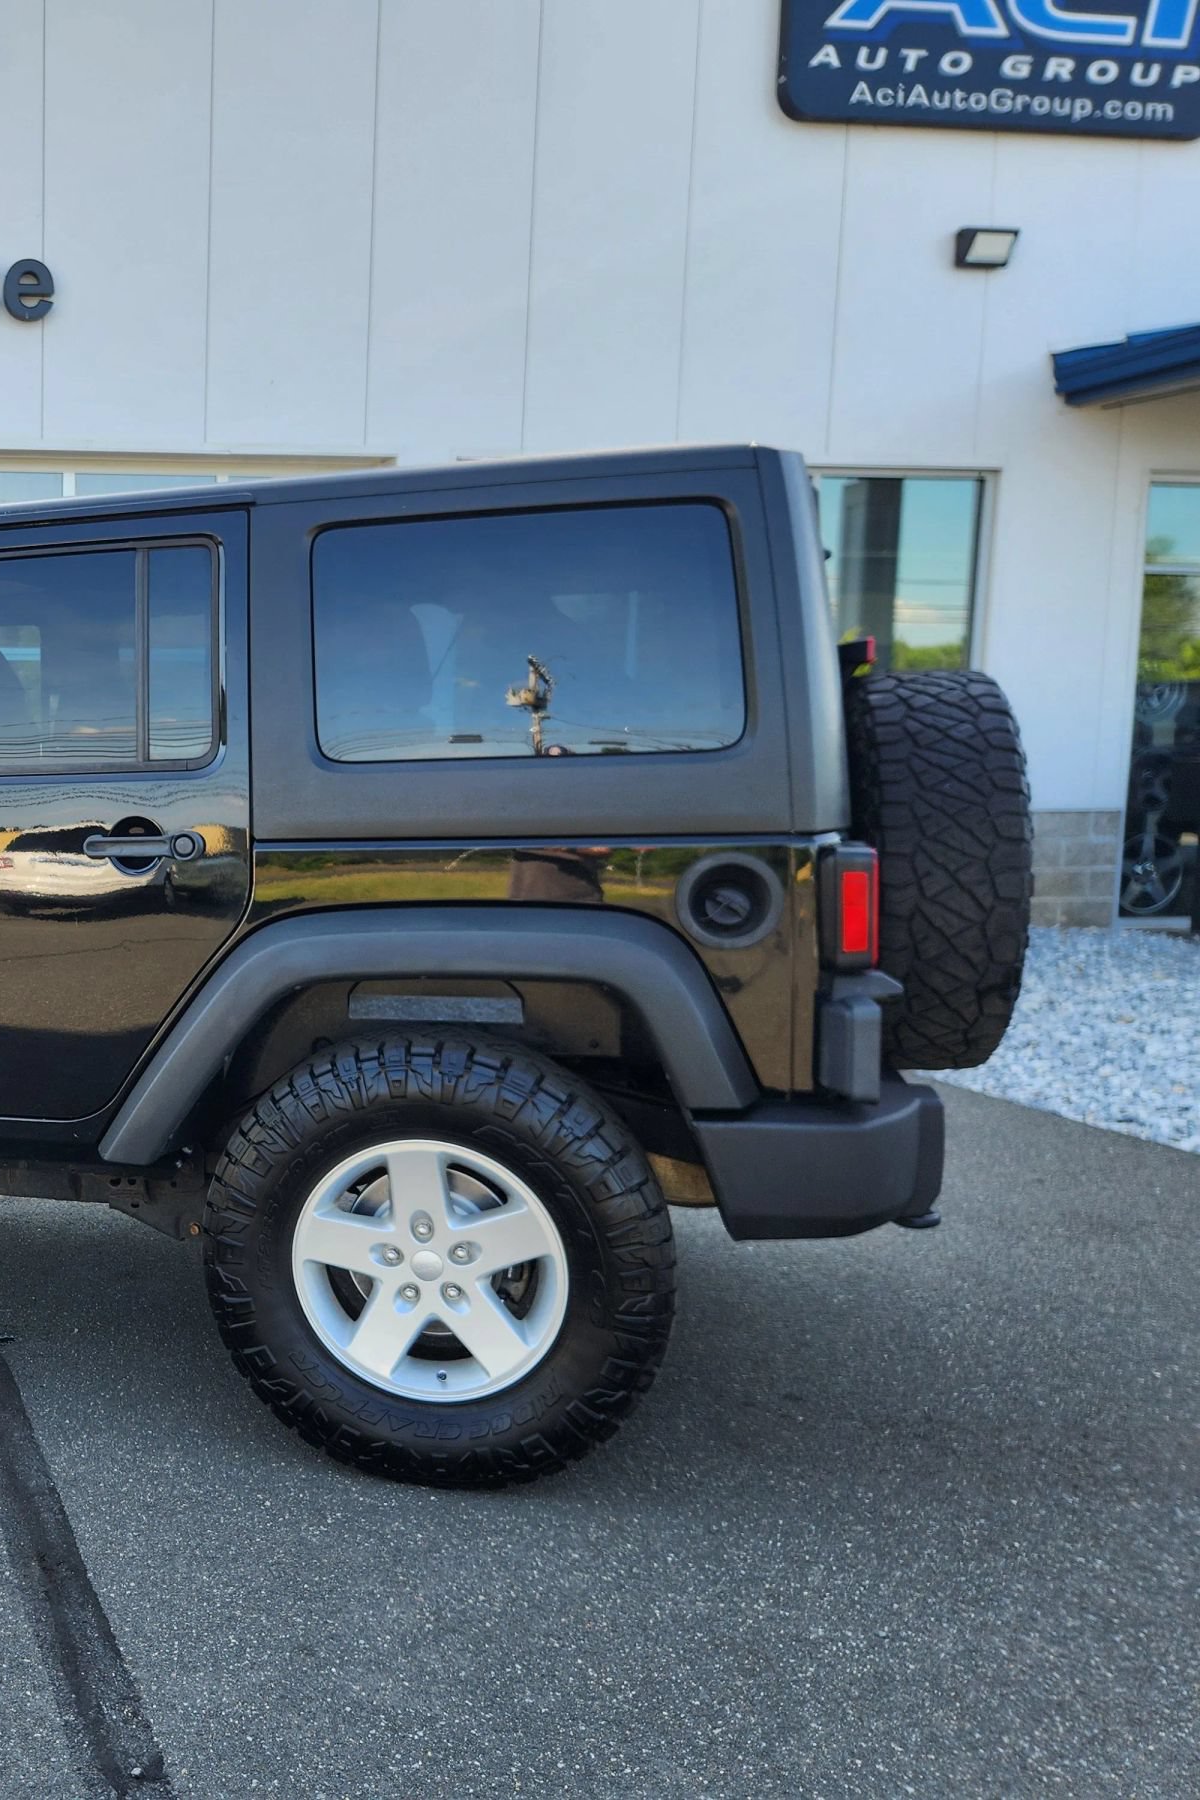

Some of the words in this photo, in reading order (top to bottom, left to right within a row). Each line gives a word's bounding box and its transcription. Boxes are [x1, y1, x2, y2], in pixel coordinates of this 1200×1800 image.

[808, 44, 974, 76] AUTO
[999, 54, 1200, 89] GROUP
[848, 81, 1175, 122] AciAutoGroup.com
